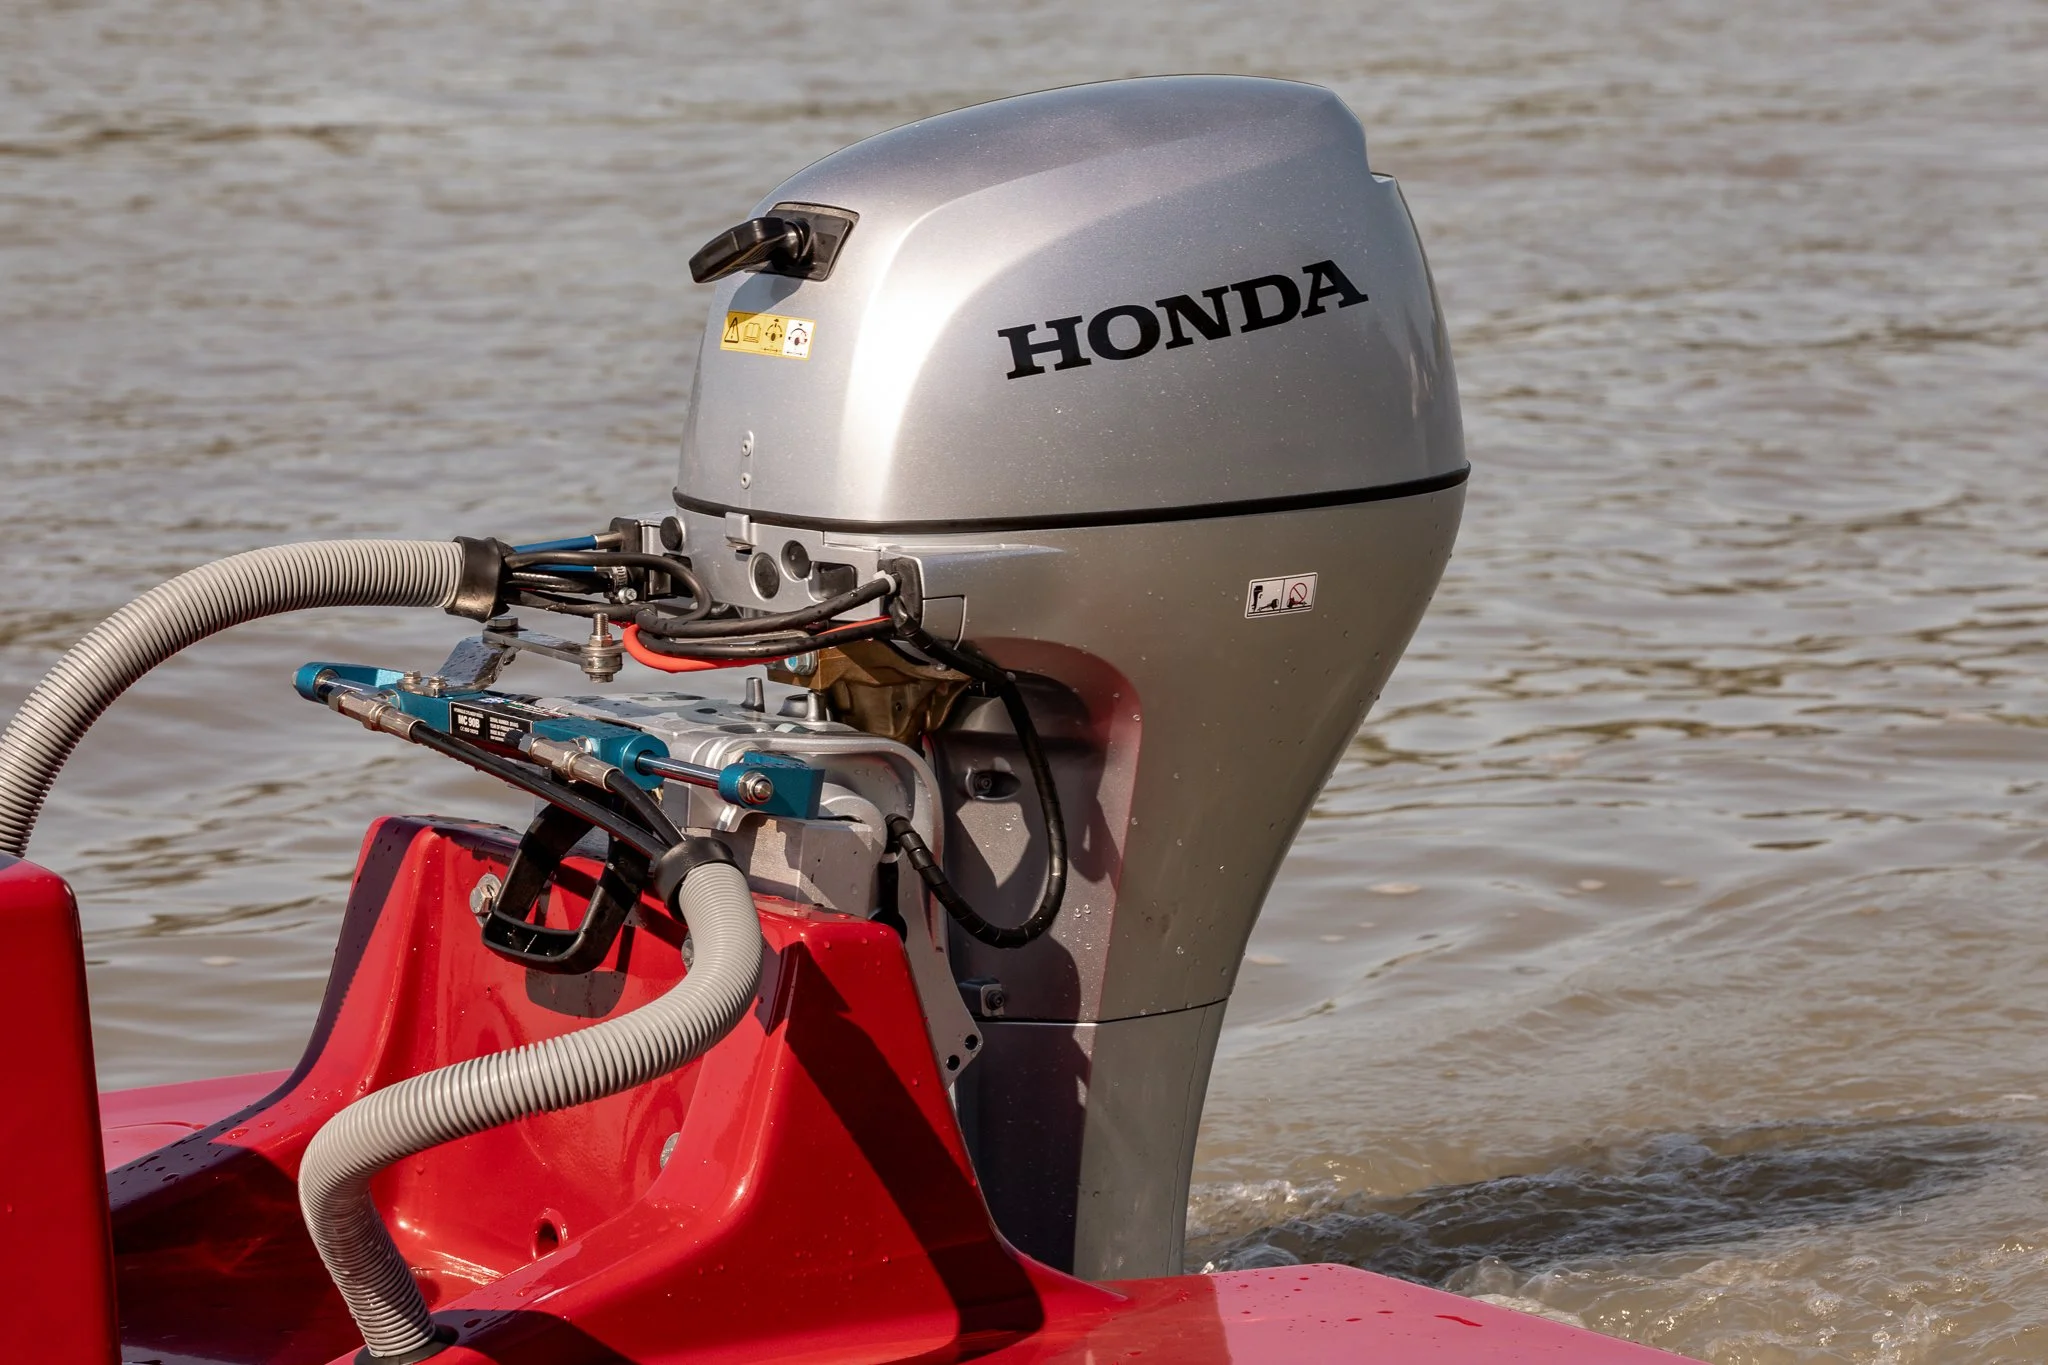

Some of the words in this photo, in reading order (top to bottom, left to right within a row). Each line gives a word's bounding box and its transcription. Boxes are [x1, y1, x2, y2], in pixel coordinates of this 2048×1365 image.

[997, 259, 1369, 380] HONDA
[457, 714, 468, 726] MC
[468, 717, 481, 728] 90B
